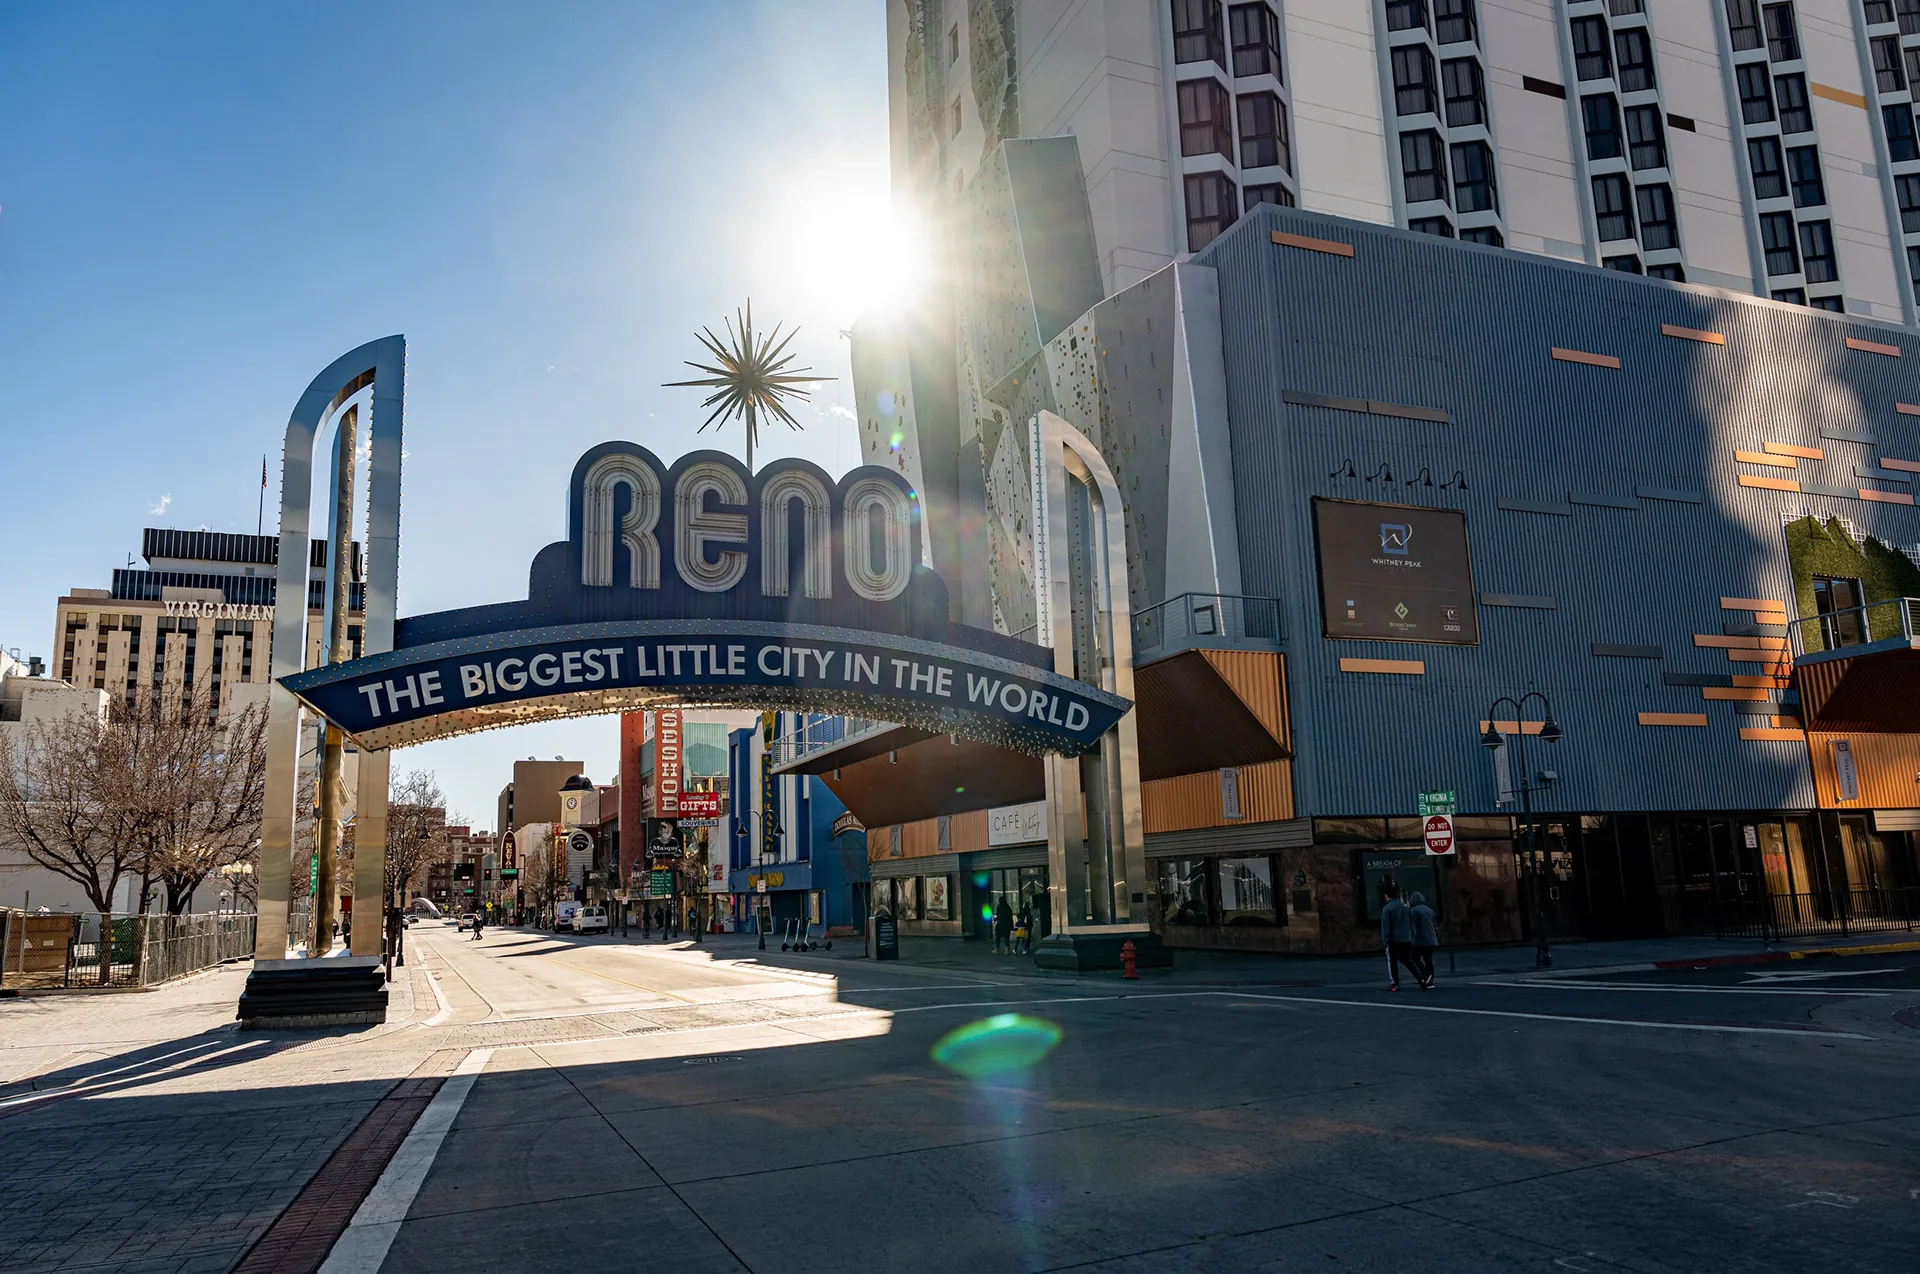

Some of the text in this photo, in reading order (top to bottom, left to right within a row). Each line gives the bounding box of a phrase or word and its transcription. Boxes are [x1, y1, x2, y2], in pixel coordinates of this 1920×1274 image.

[1371, 558, 1422, 568] WHITNEY PEAK
[164, 600, 276, 621] VIRGINIAN
[358, 645, 1090, 732] THE BIGGEST LITTLE CITY IN THE WORLD
[680, 800, 717, 811] GIFTS
[1438, 822, 1448, 830] NOT
[1431, 839, 1448, 847] ENTER
[1394, 859, 1402, 867] OF
